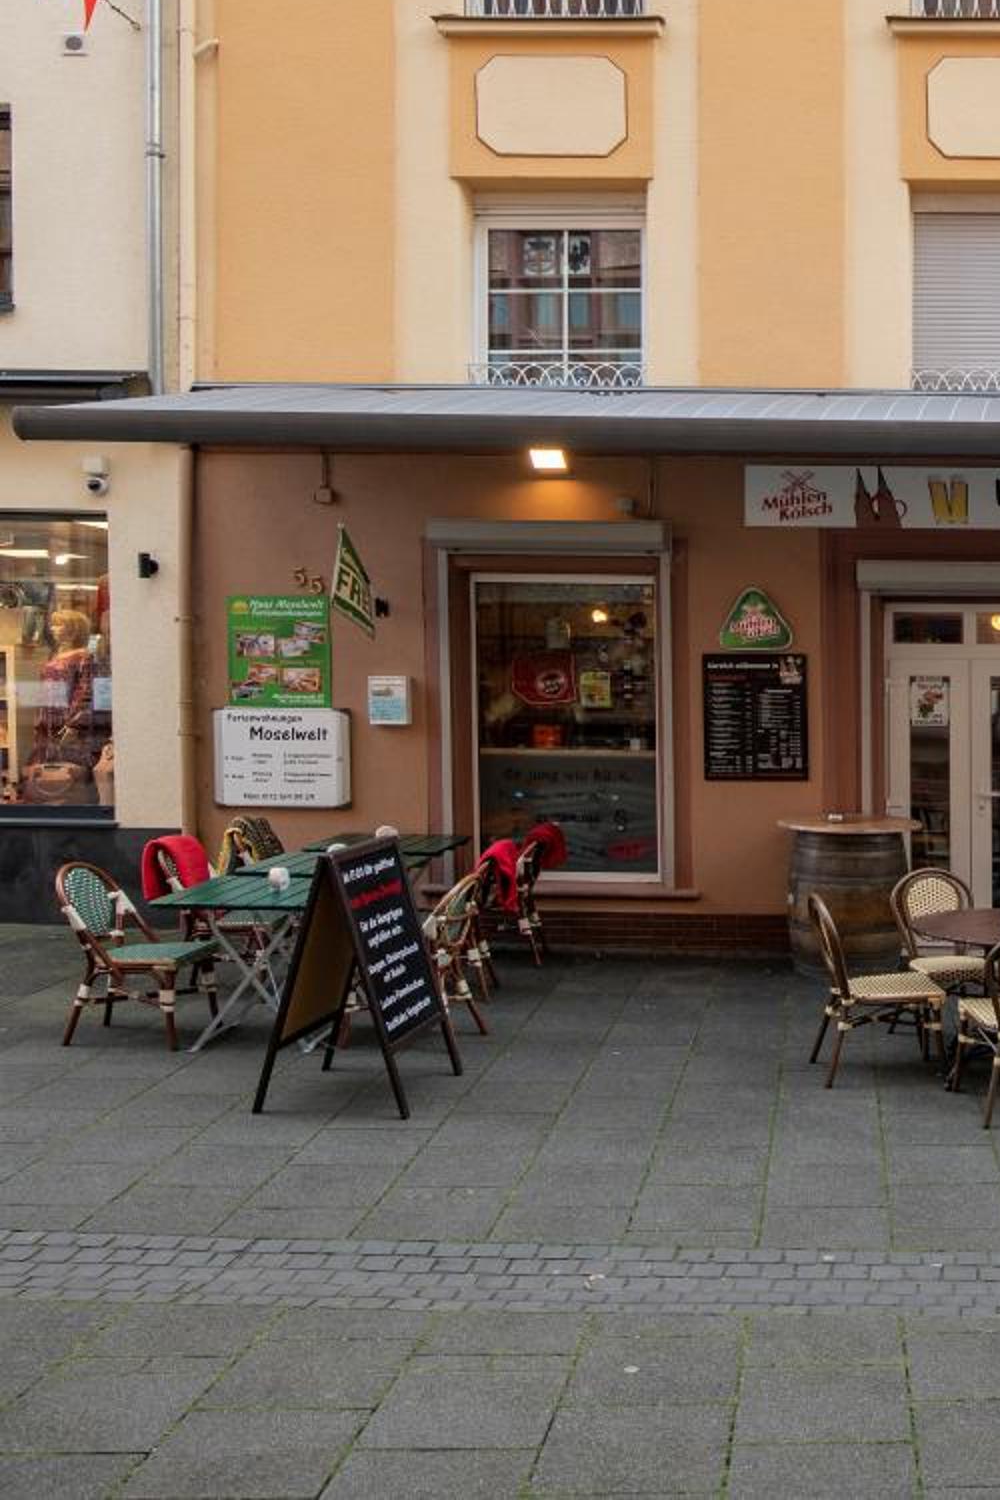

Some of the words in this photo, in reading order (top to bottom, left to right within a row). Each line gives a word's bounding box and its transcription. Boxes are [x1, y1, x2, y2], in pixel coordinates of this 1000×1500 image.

[761, 491, 827, 511] Mühlen
[779, 501, 833, 522] Kölsch
[227, 713, 303, 724] Ferienwohnungen
[249, 726, 328, 741] Moselwelt
